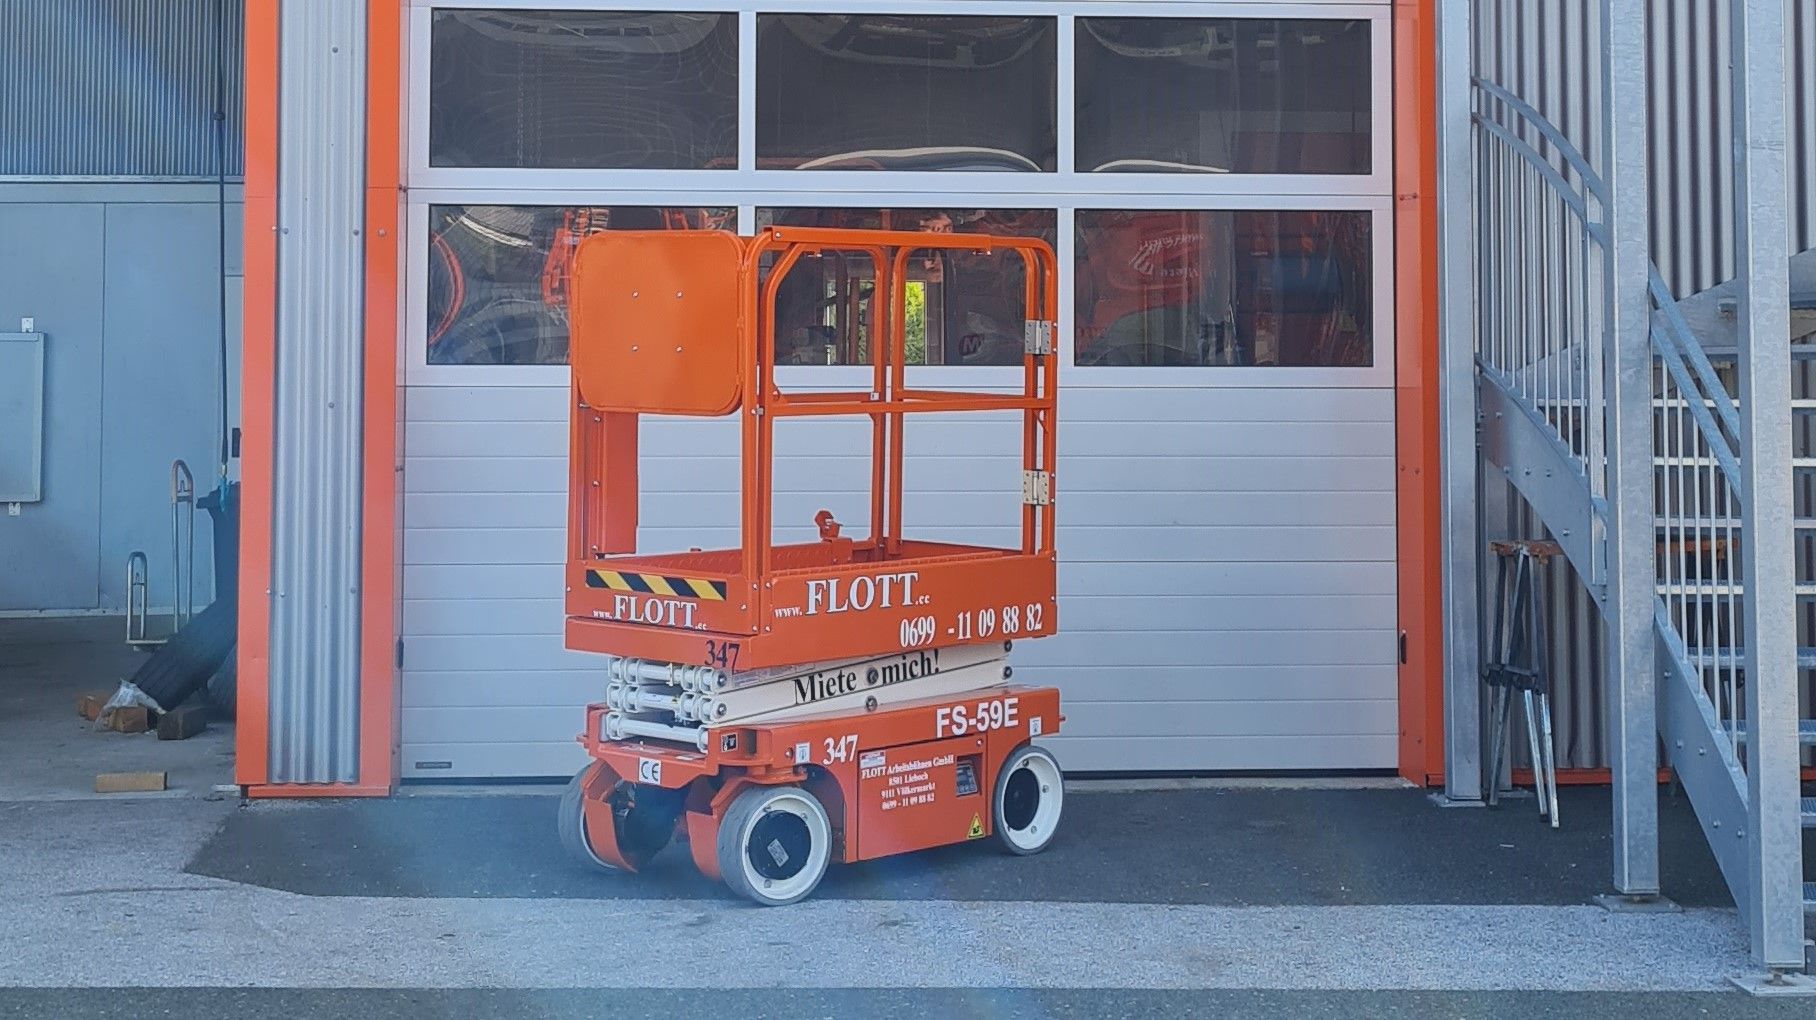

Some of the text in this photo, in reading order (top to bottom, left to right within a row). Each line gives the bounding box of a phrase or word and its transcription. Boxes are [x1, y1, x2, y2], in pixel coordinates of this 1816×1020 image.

[900, 616, 936, 647] 0699
[978, 608, 996, 637] 09
[1002, 605, 1020, 634] 88
[1026, 603, 1043, 632] 82
[704, 640, 740, 674] 347
[793, 649, 940, 705] Miete mich!
[936, 697, 1019, 738] FS-59E
[823, 734, 859, 765] 347
[861, 766, 887, 780] FLOTT
[932, 754, 954, 767] GmbH
